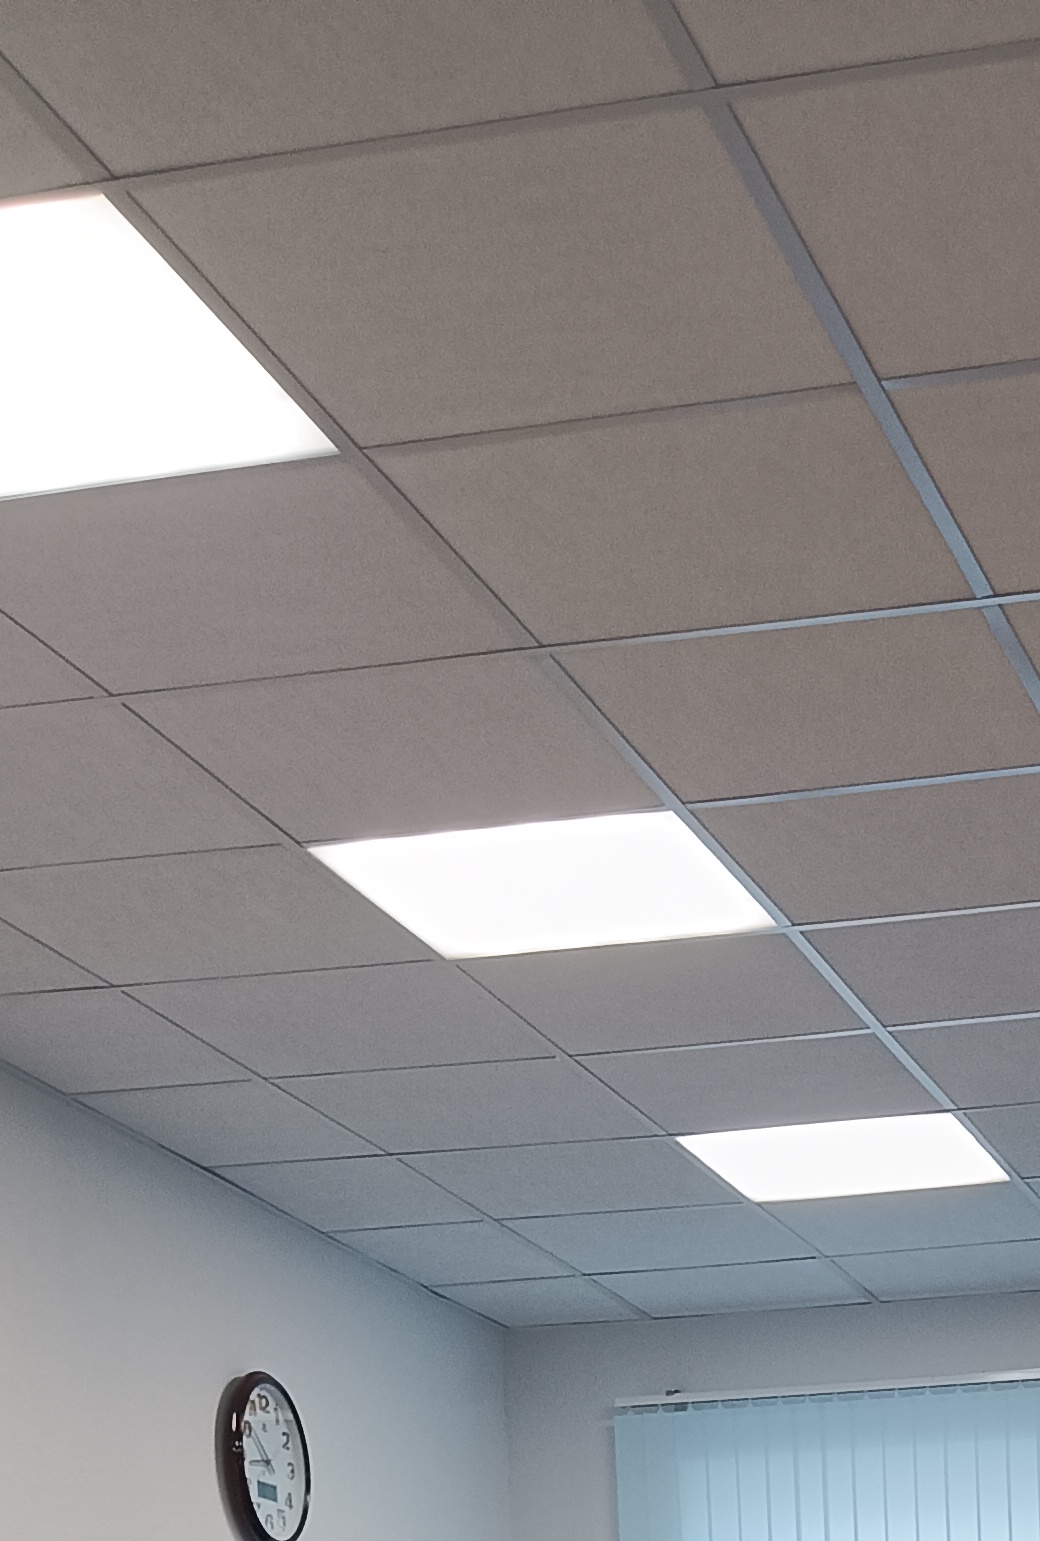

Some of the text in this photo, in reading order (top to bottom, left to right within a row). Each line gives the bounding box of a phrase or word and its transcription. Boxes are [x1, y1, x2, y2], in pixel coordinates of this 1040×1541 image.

[281, 1432, 290, 1450] 2
[286, 1462, 295, 1480] 3
[285, 1492, 294, 1510] 4
